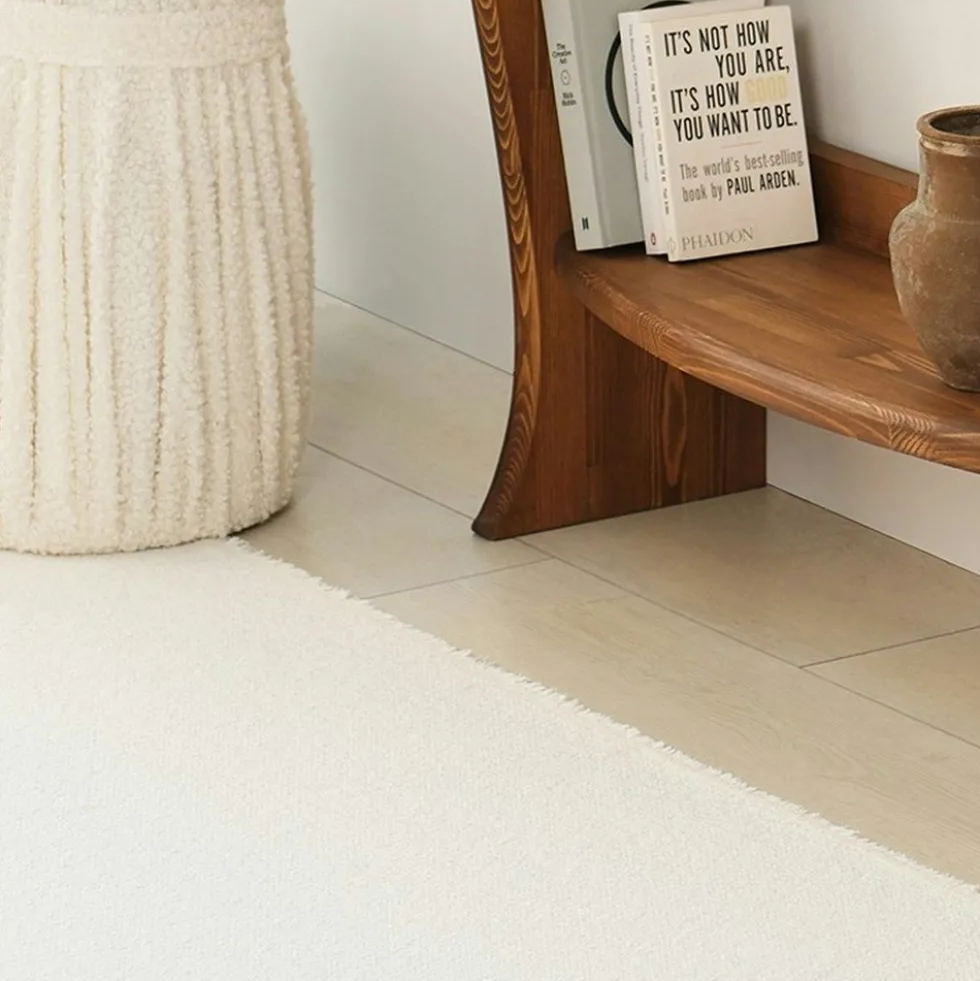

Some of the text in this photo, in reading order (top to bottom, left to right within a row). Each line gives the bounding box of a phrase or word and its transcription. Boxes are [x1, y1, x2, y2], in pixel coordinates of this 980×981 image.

[664, 20, 769, 57] IT'S NOT HOW
[715, 46, 790, 78] YOU ARE,
[670, 86, 700, 114] IT'S
[705, 81, 739, 109] HOW
[674, 103, 798, 142] YOU WANT TO BE.
[679, 149, 804, 180] The world's best-selling
[682, 169, 800, 202] book by PAUL ARDEN.
[681, 226, 754, 251] PHAIDON
